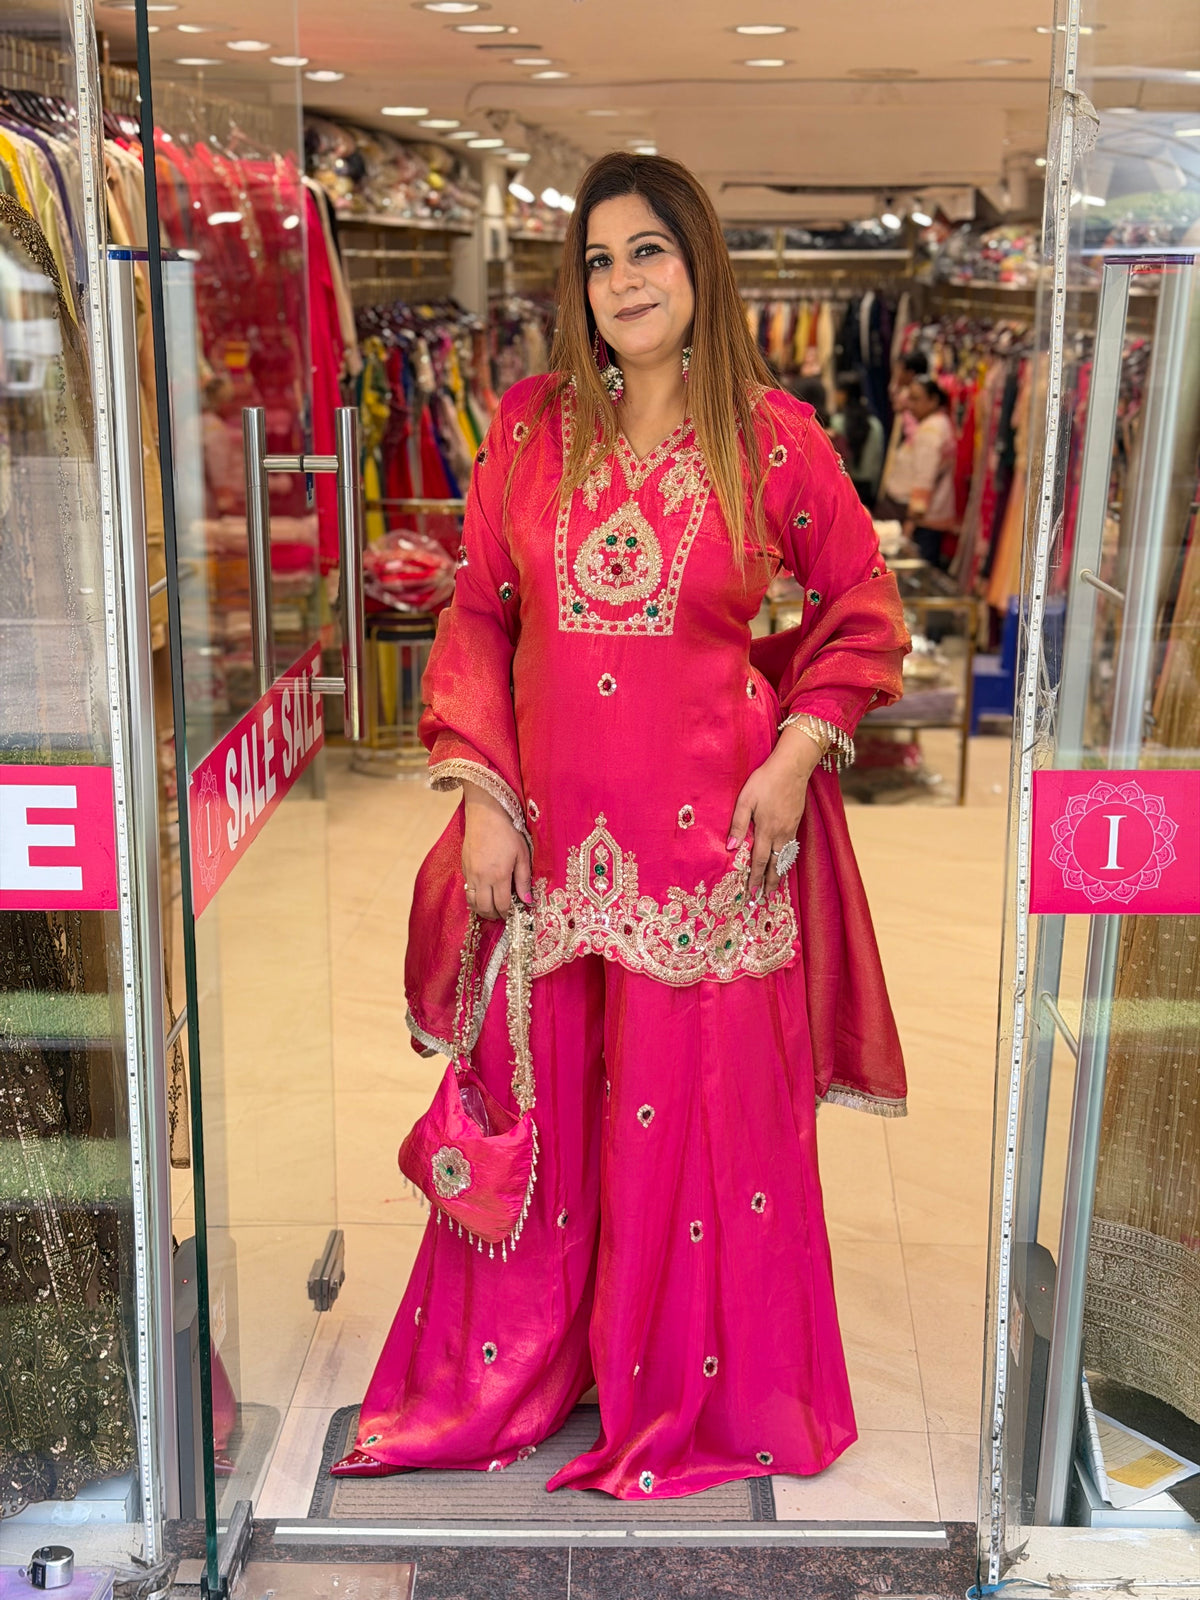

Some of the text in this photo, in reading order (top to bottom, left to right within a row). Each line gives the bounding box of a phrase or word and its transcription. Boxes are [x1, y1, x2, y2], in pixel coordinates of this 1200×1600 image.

[225, 704, 277, 851] SALE
[281, 654, 322, 779] SALE
[1100, 815, 1127, 870] I
